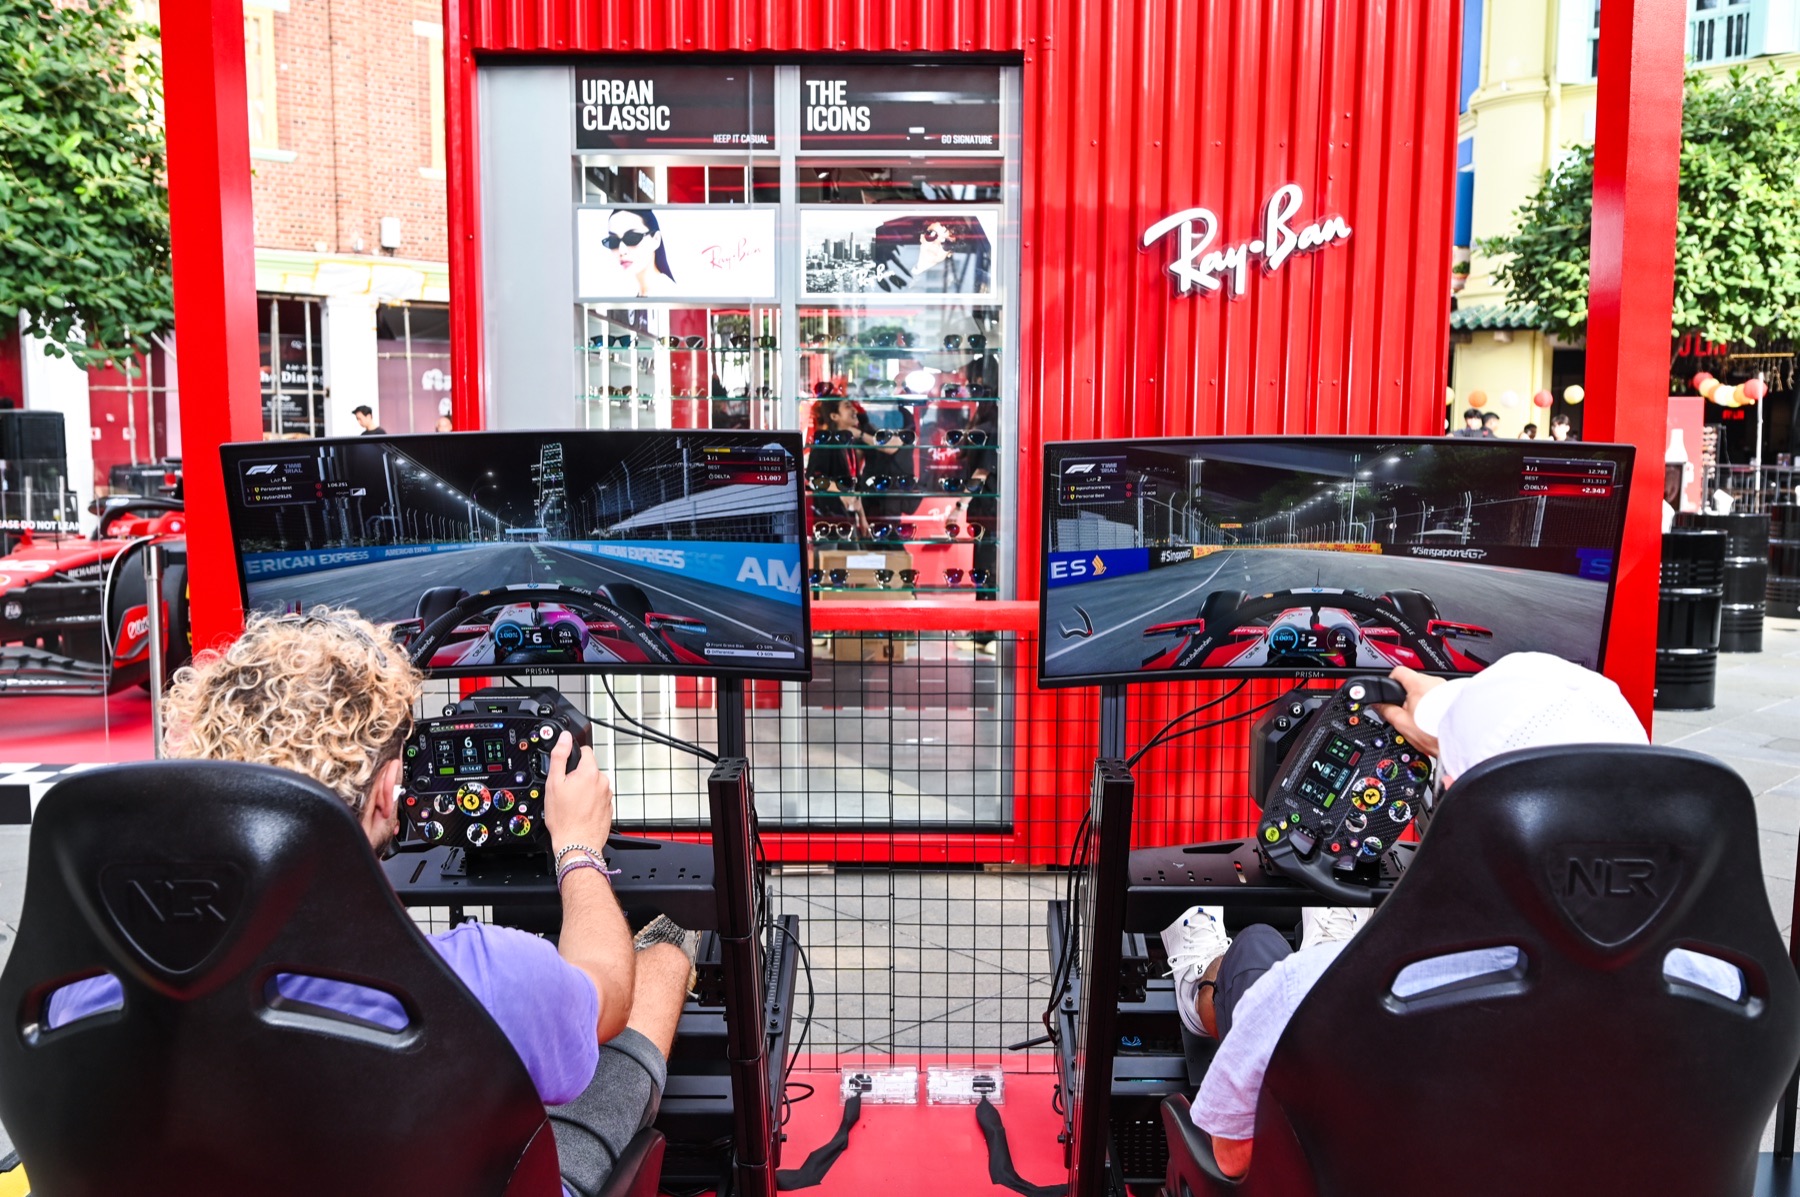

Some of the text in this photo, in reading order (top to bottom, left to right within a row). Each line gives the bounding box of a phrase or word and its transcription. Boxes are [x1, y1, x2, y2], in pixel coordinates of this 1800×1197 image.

[582, 79, 654, 105] URBAN
[806, 80, 847, 105] THE
[582, 105, 670, 131] CLASSIC
[806, 106, 871, 132] ICONS
[713, 134, 769, 144] KEEP IT CASUAL
[941, 135, 993, 145] GO SIGNATURE
[21, 520, 35, 530] DO
[36, 520, 57, 530] NOT
[318, 550, 370, 566] EXPRESS
[532, 632, 543, 645] 6
[1307, 636, 1317, 648] 2
[464, 736, 473, 748] 6
[1312, 760, 1325, 772] 2
